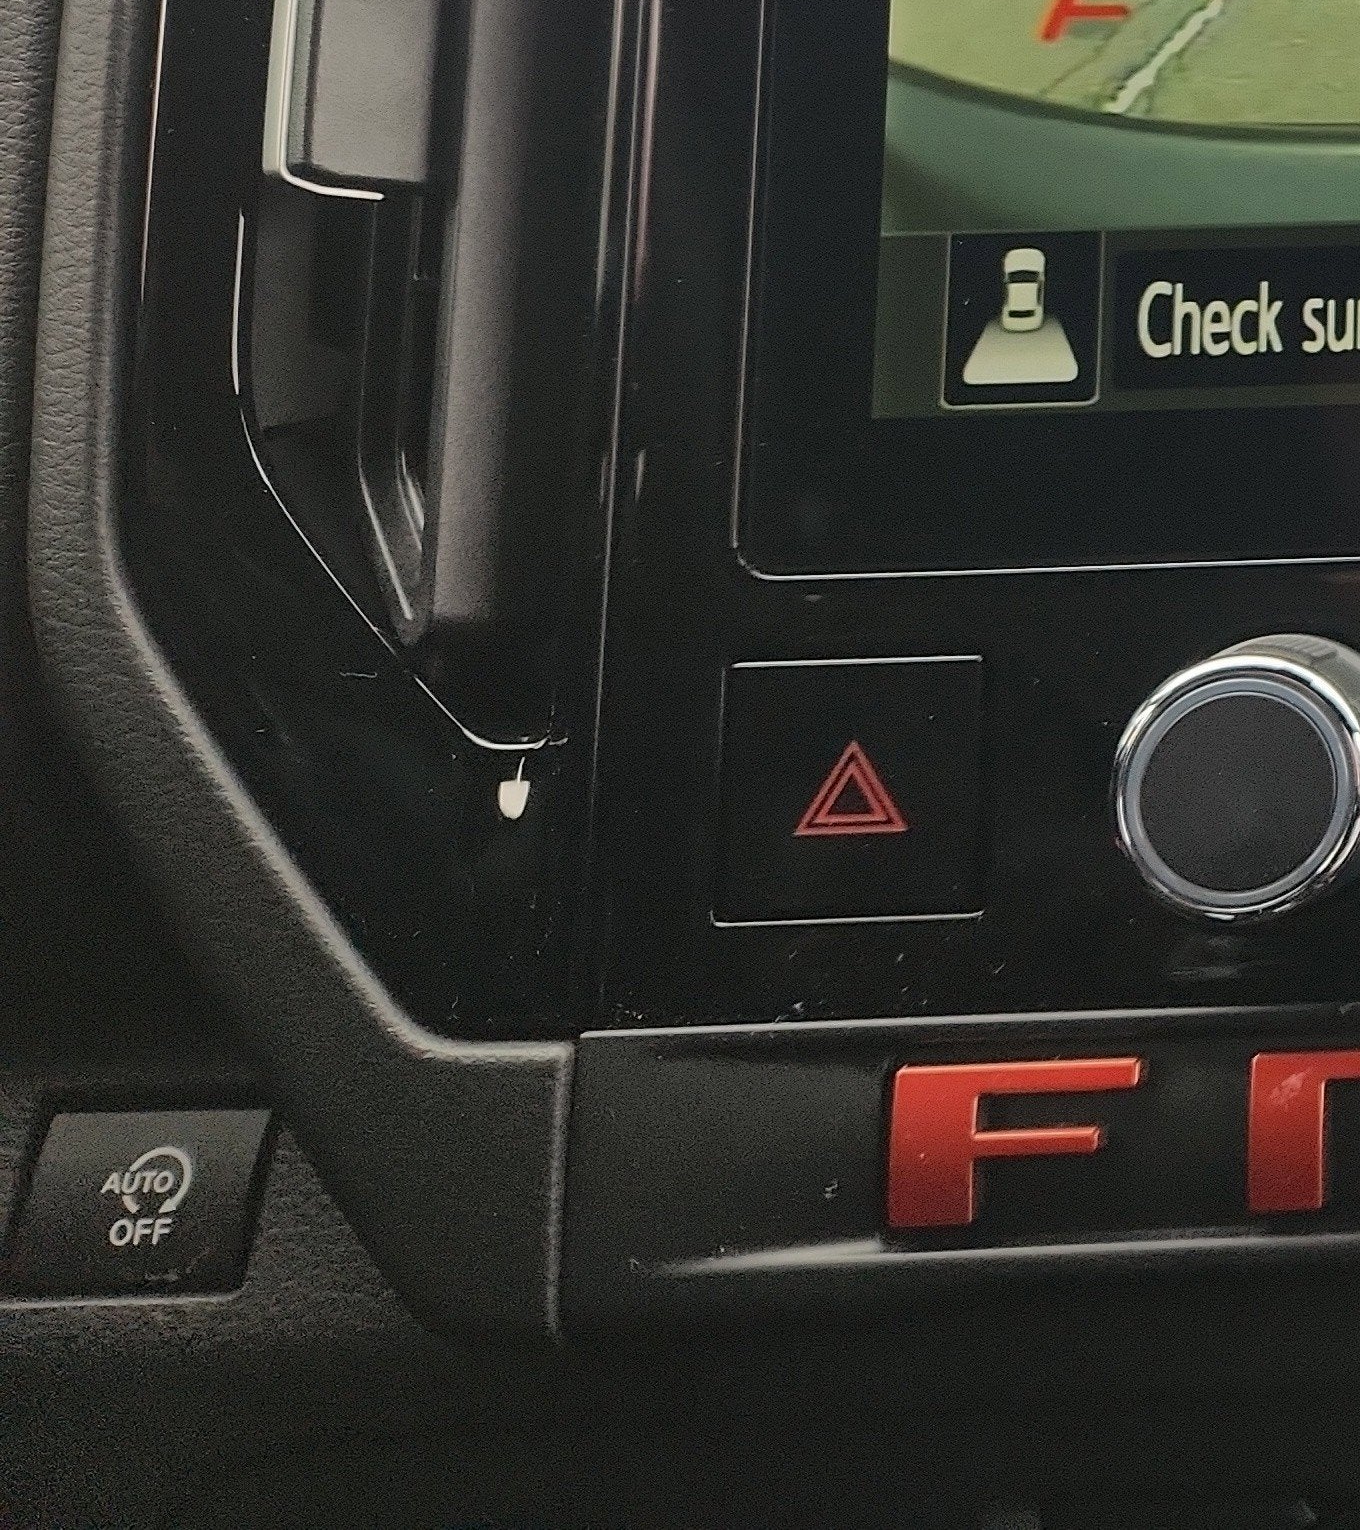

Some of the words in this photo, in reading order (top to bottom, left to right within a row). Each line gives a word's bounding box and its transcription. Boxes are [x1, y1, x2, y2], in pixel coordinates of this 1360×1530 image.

[1137, 280, 1284, 360] Check
[100, 1170, 175, 1194] AUTO
[108, 1218, 174, 1247] OFF
